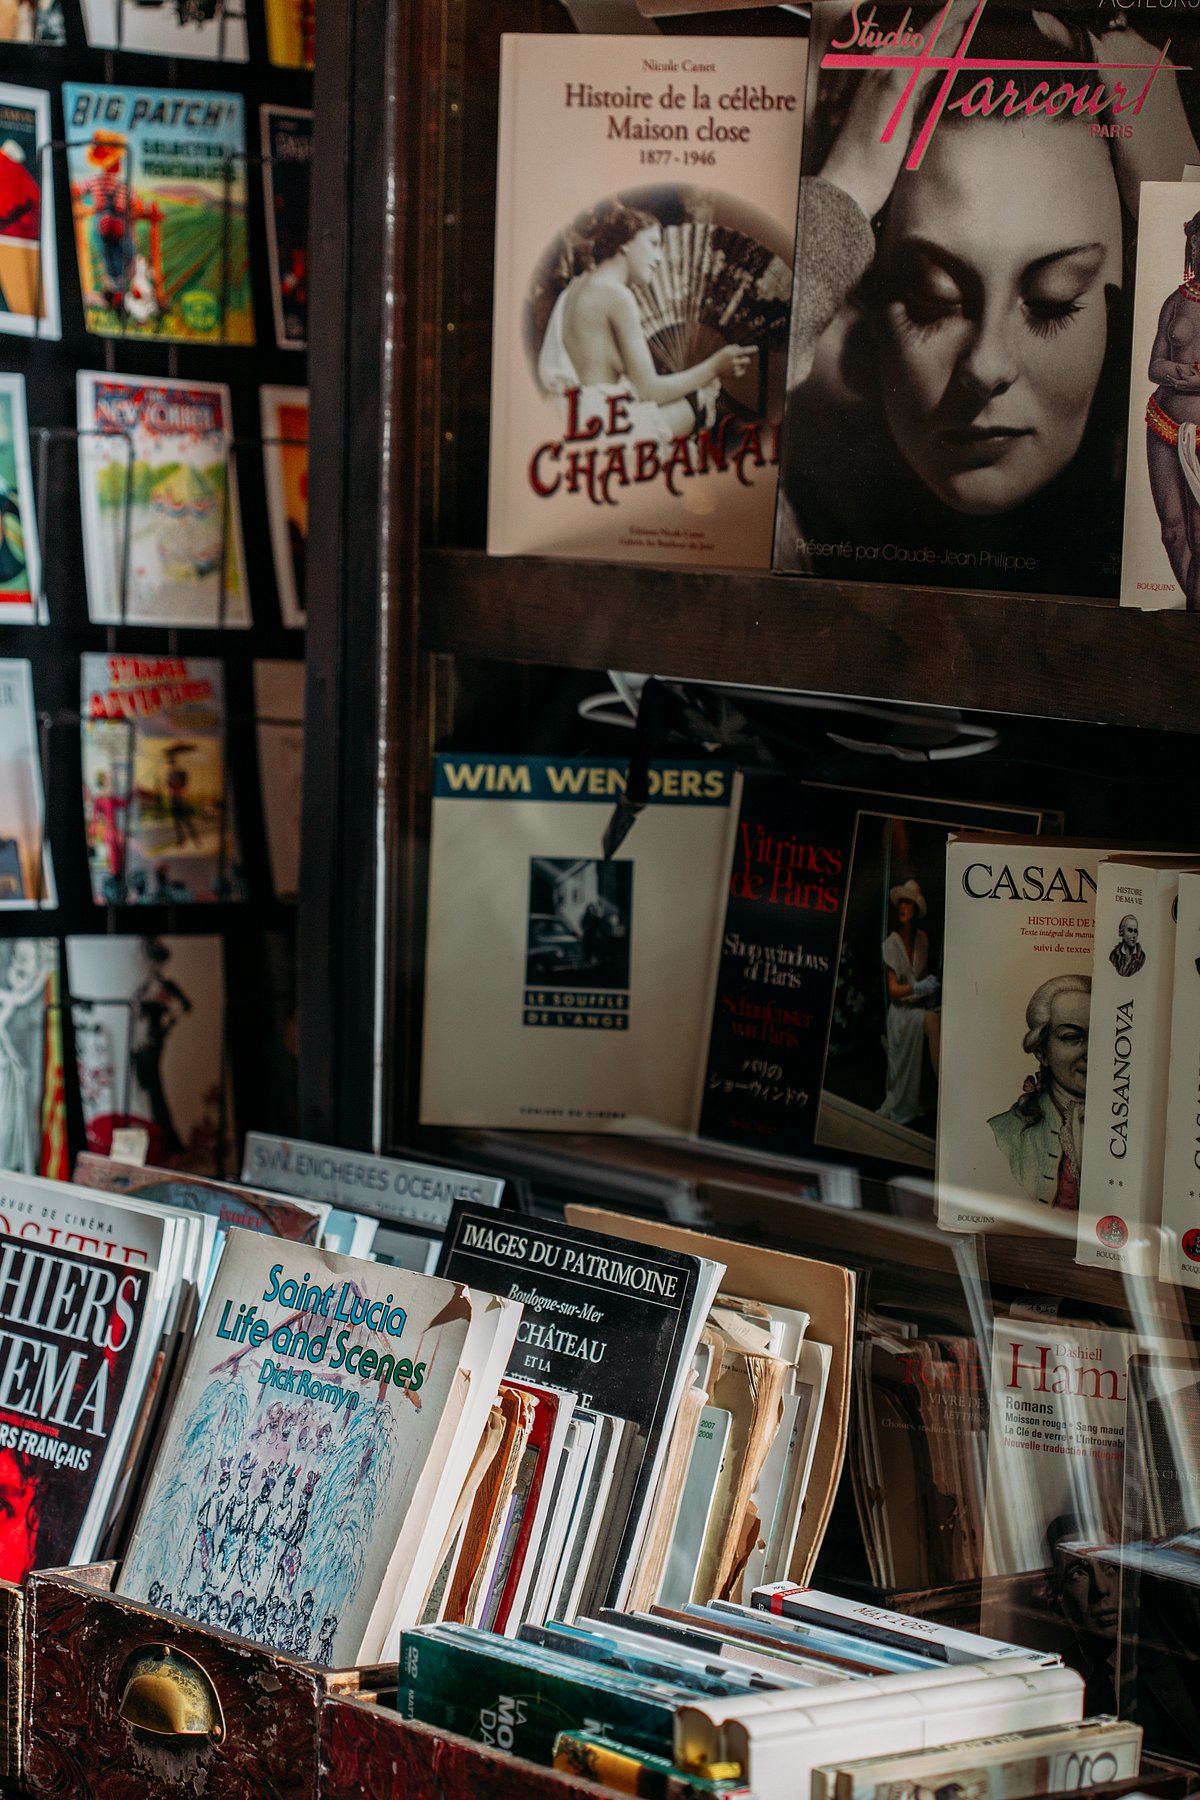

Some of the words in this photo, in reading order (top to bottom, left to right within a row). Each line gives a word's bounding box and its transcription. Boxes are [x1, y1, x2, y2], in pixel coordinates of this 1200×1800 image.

[832, 0, 925, 49] Studio
[565, 83, 653, 109] Histoire
[659, 85, 686, 110] de
[693, 85, 712, 110] la
[718, 86, 797, 111] célèbre
[820, 0, 1193, 170] Harcourt
[71, 91, 125, 127] BIG
[607, 116, 688, 141] Maison
[696, 117, 750, 142] close
[1090, 124, 1134, 139] PARIS
[640, 150, 672, 165] 1877
[683, 151, 716, 166] 1946
[563, 387, 636, 443] LE
[795, 538, 853, 558] Présenté
[856, 545, 880, 561] par
[882, 543, 976, 566] Claude-Jean
[979, 550, 1037, 573] Philippe
[443, 763, 531, 793] WIM
[547, 766, 725, 797] WENDERS
[741, 821, 842, 876] Vitrines
[730, 863, 764, 900] de
[767, 865, 839, 914] Paris
[1117, 886, 1143, 897] HISTOIRE
[1020, 928, 1038, 937] Texte
[1065, 929, 1075, 938] du
[1028, 916, 1075, 928] HISTOIRE
[1077, 917, 1090, 928] DE
[1033, 943, 1053, 953] suivi
[1054, 944, 1065, 953] de
[1066, 945, 1091, 954] textes
[553, 993, 625, 1008] SOUFFLE
[1109, 999, 1134, 1160] CASANOVA
[41, 1207, 57, 1220] DE
[65, 1213, 113, 1234] CINÉMA
[957, 1215, 995, 1224] BOUQUINS
[461, 1223, 528, 1260] IMAGES
[528, 1241, 560, 1268] DU
[561, 1250, 678, 1299] PATRIMOINE
[0, 1242, 142, 1353] HIERS
[262, 1264, 334, 1316] Saint
[333, 1282, 408, 1338] Lucia
[507, 1283, 605, 1323] Boulogne-sur-Mer
[216, 1300, 268, 1348] Life
[272, 1326, 332, 1370] and
[329, 1330, 427, 1391] Scenes
[515, 1320, 607, 1363] CHÂTEAU
[1056, 1344, 1103, 1361] Dashiell
[524, 1355, 538, 1369] ET
[537, 1358, 551, 1373] LA
[1007, 1342, 1127, 1402] Ham
[0, 1330, 106, 1438] EMA
[258, 1358, 301, 1393] Dick
[299, 1370, 360, 1413] Romyn
[929, 1393, 966, 1407] VIVRE
[1005, 1396, 1054, 1415] Romans
[698, 1430, 713, 1440] 2008
[700, 1420, 715, 1430] 2007
[1004, 1425, 1014, 1434] La
[1016, 1426, 1030, 1437] Clé
[1031, 1429, 1042, 1439] de
[1044, 1432, 1067, 1441] verre
[1005, 1412, 1040, 1426] Moisson
[1042, 1418, 1067, 1430] rouge
[1076, 1422, 1098, 1434] Sang
[17, 1429, 92, 1471] FRANÇAIS
[1004, 1437, 1041, 1451] Nouvelle
[1043, 1443, 1087, 1456] traduction
[853, 1607, 938, 1634] MAFIOSA
[496, 1694, 515, 1757] MO
[515, 1700, 528, 1725] LA
